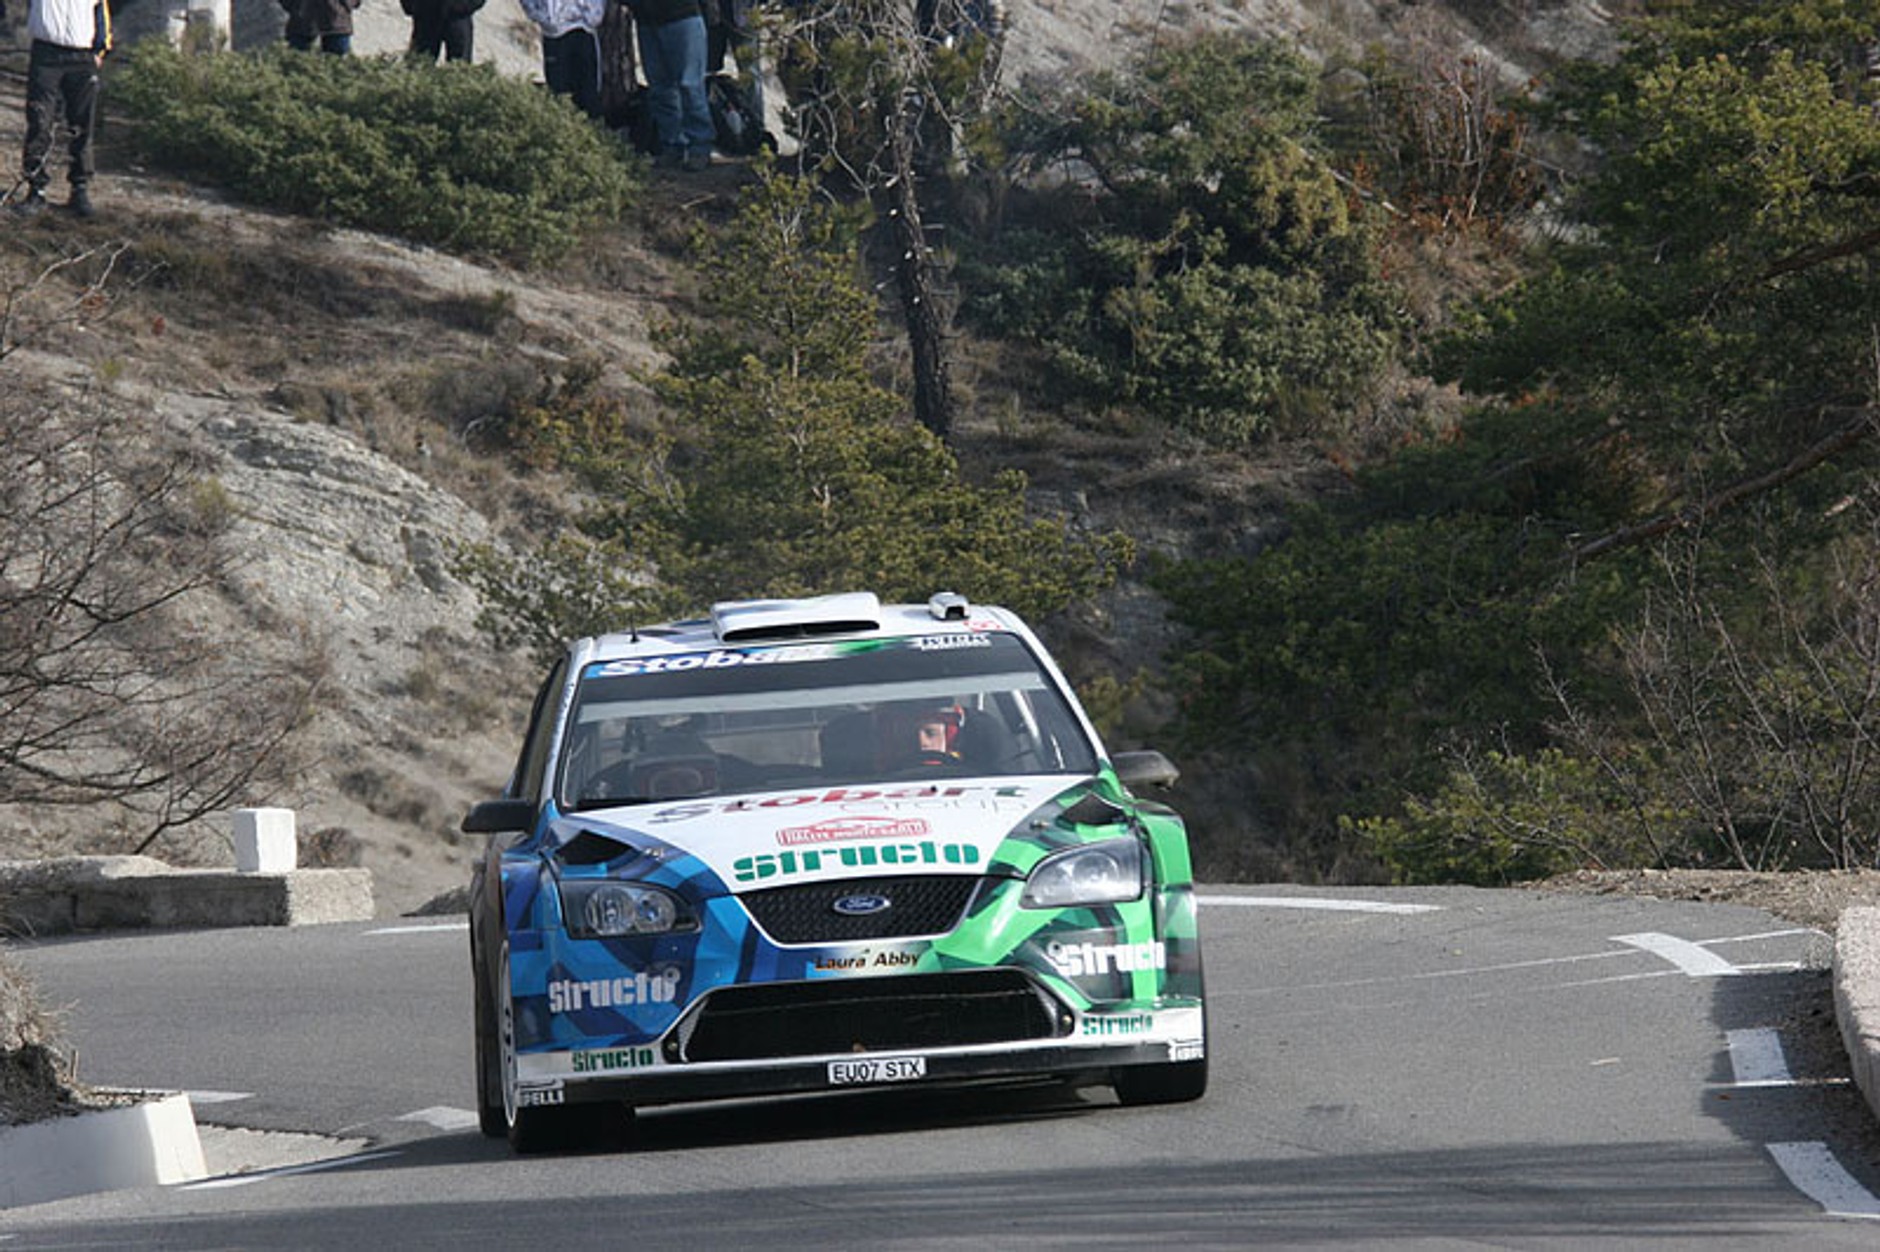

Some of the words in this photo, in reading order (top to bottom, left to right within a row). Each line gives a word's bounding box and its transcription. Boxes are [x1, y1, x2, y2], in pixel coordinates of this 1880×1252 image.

[814, 956, 866, 970] Laura
[874, 952, 919, 967] Abby
[833, 1062, 880, 1081] EU07
[885, 1061, 920, 1077] STX
